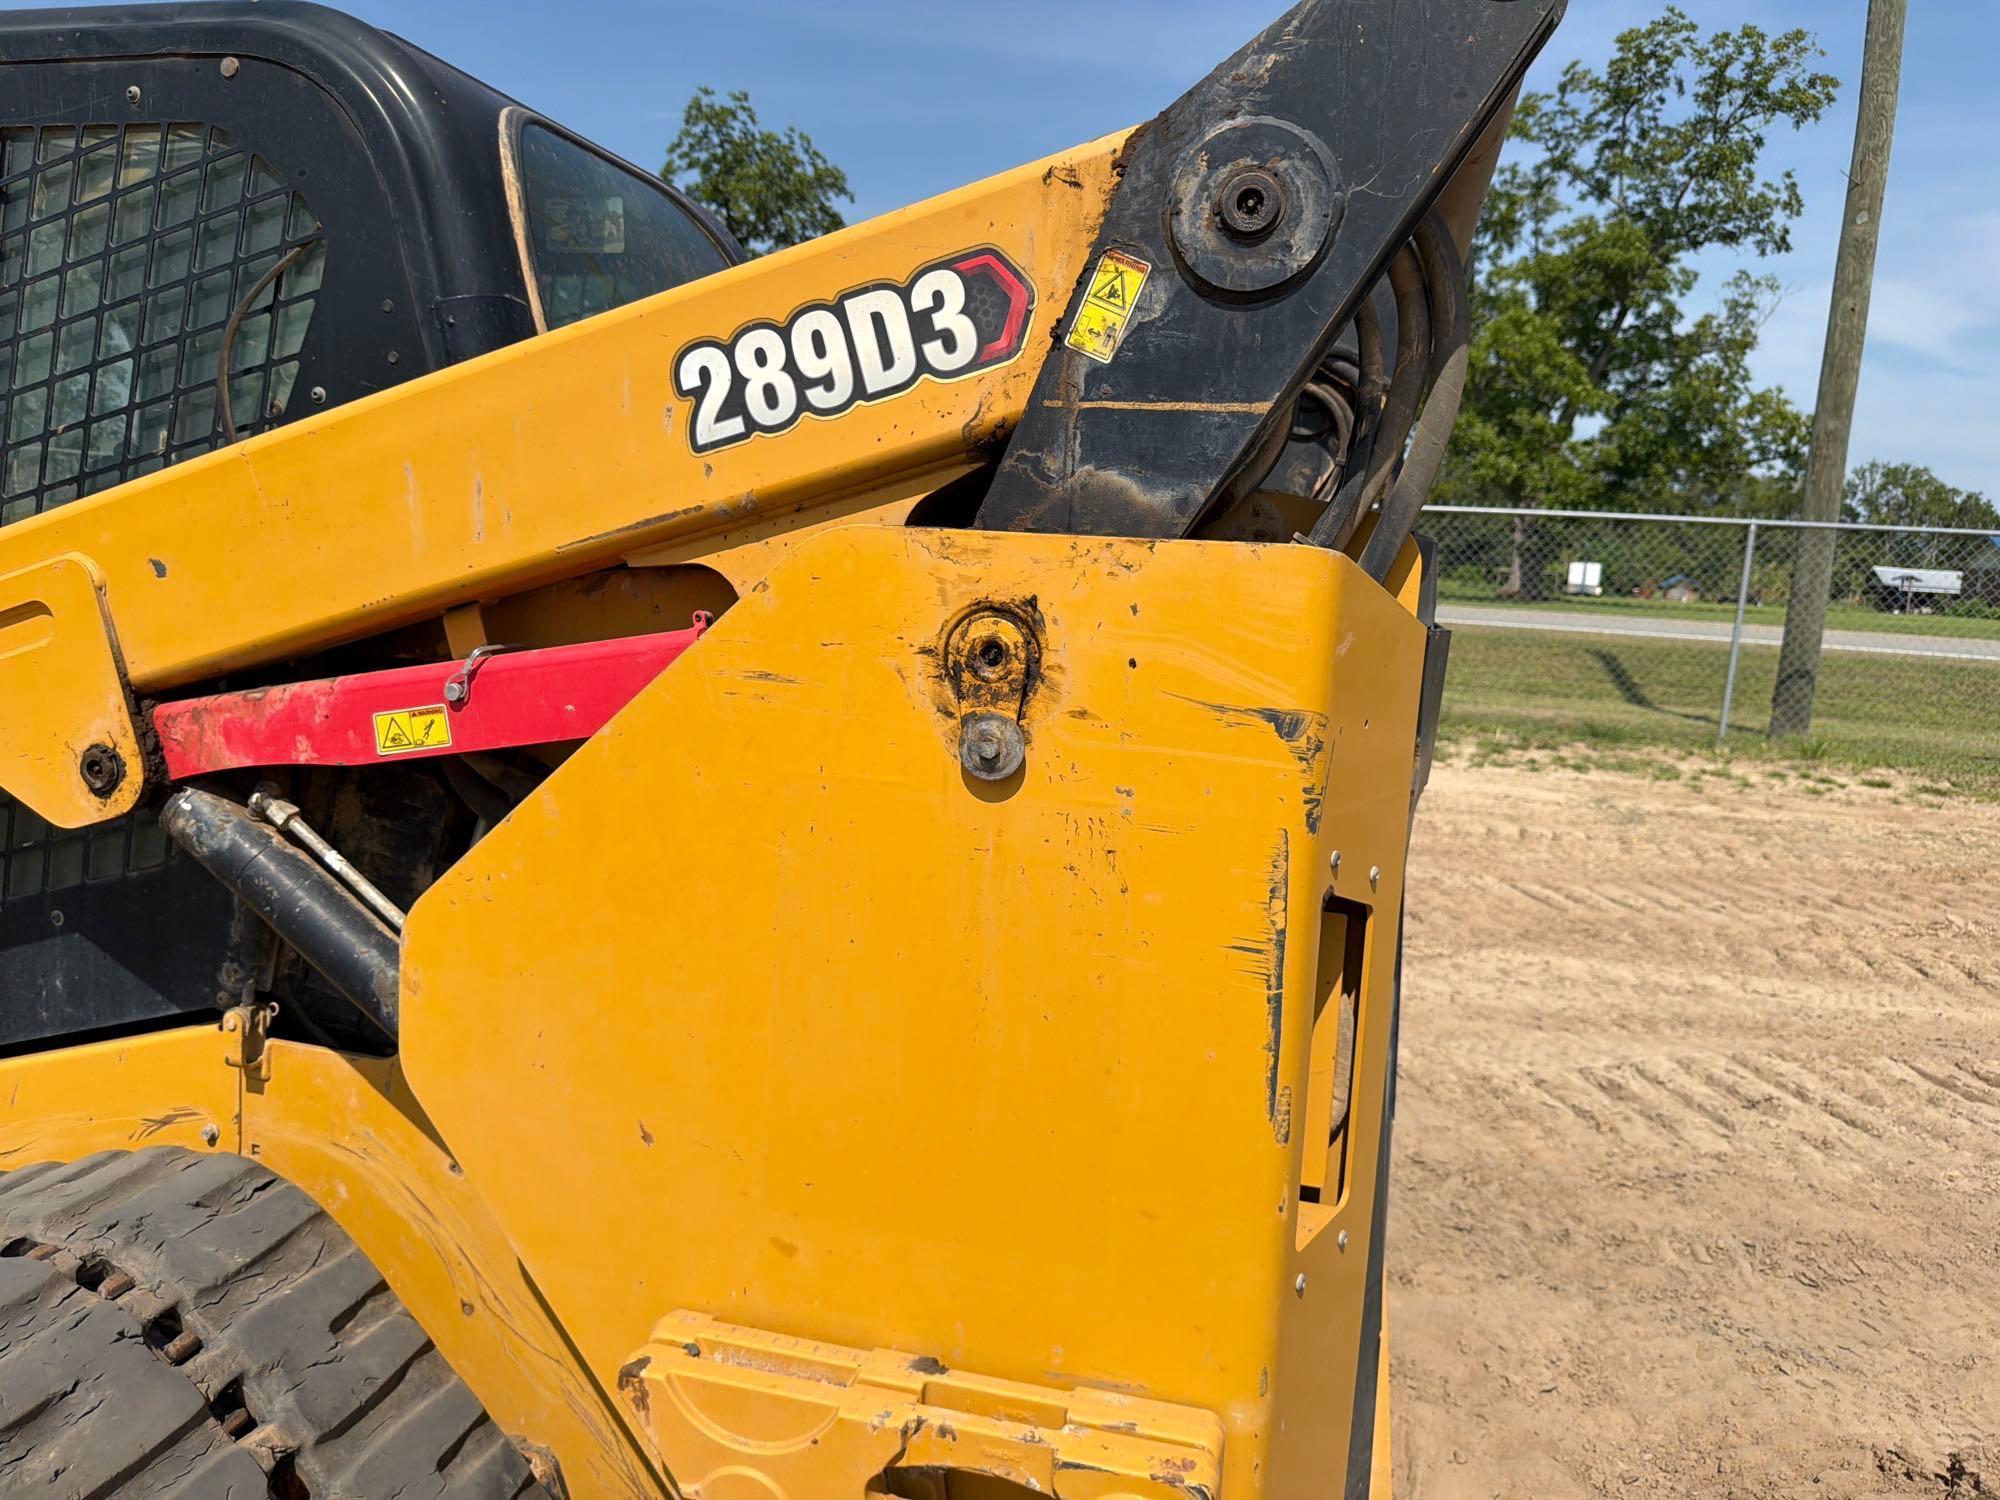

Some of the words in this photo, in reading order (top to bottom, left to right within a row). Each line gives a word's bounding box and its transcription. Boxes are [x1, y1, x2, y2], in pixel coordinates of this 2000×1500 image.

[1114, 256, 1146, 274] WARNING
[678, 269, 978, 447] 289D3
[418, 708, 443, 717] WARNING
